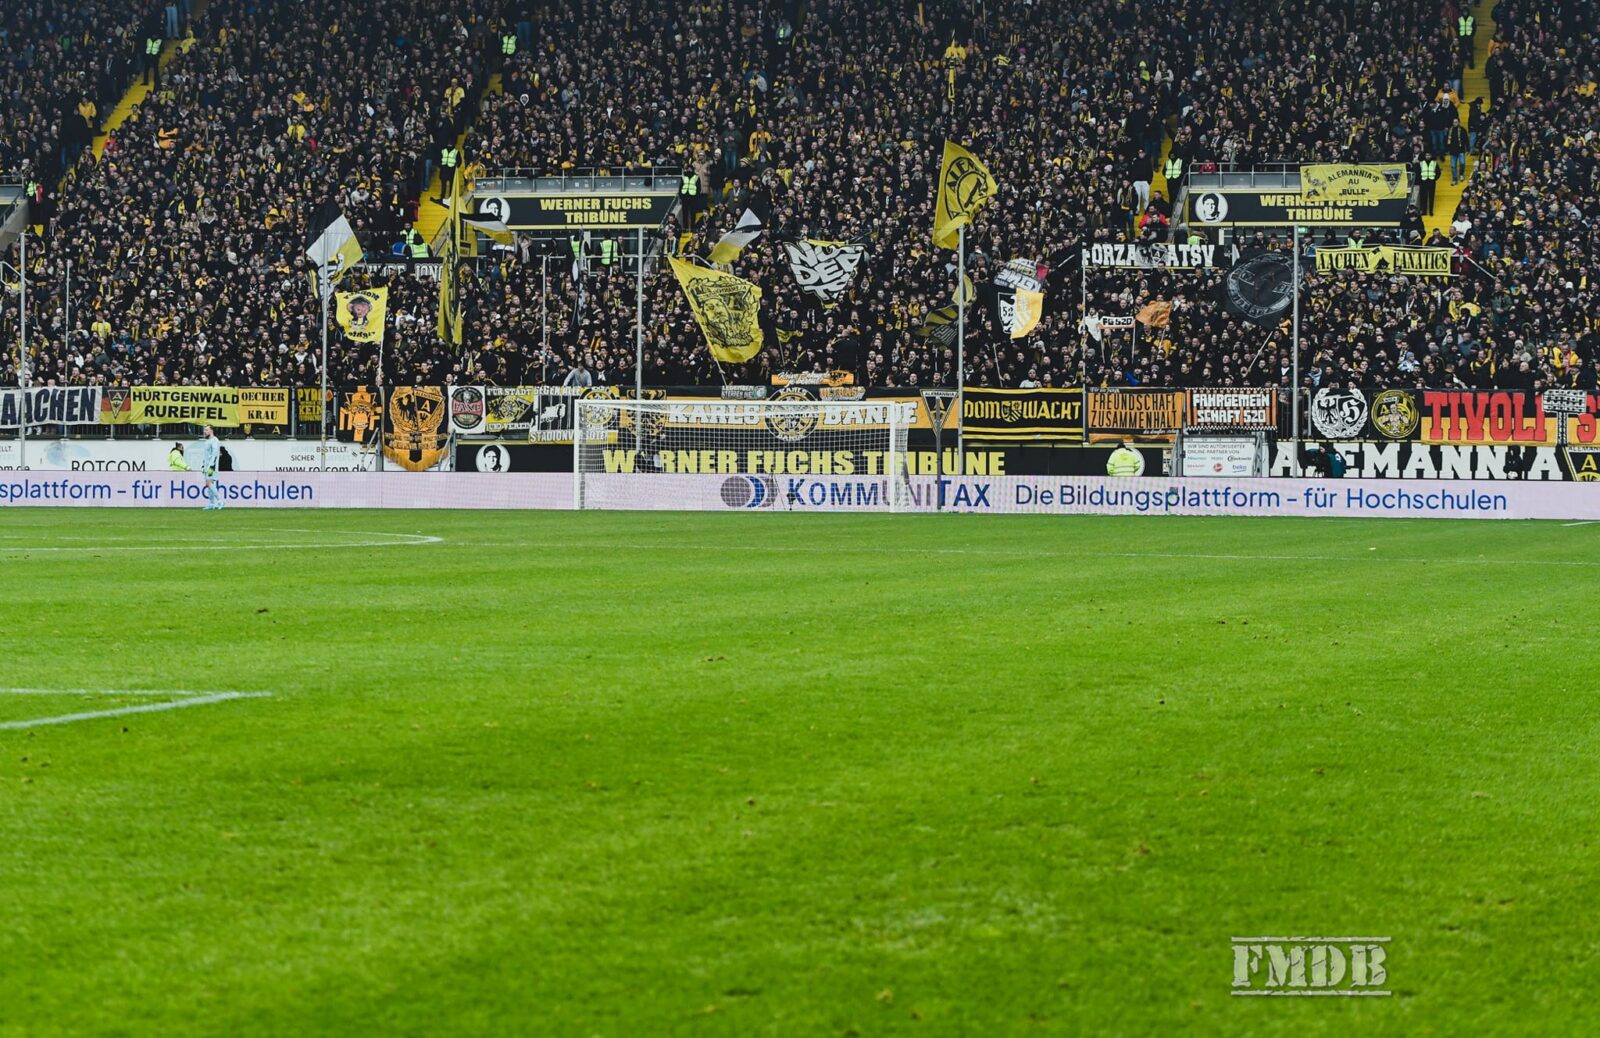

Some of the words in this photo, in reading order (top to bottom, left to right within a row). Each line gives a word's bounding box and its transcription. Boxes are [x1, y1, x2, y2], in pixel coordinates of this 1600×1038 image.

[540, 198, 600, 210] WERNER
[604, 198, 652, 210] FUCHS
[564, 210, 627, 223] TRIBÜNE
[1286, 207, 1353, 220] TRIBÜNE
[1168, 244, 1215, 267] ATSV
[1317, 251, 1370, 270] AACHEN
[1393, 252, 1448, 270] FANATICS
[132, 389, 239, 404] HÜRTGENWALD
[241, 392, 285, 402] OECHER
[487, 388, 502, 396] FÜR
[504, 387, 532, 396] STADT
[1, 388, 96, 425] AACHEN
[1092, 392, 1176, 410] FREUNDSCHAFT
[144, 405, 227, 420] RUREIFEL
[247, 410, 278, 420] KRAU
[963, 400, 1000, 418] DOM
[1022, 400, 1081, 420] WACHT
[1197, 409, 1240, 422] SCHAFT
[1243, 409, 1266, 422] 520
[1424, 391, 1547, 442] TIVOLI
[1091, 410, 1177, 428] ZUSAMMENHALT
[71, 460, 146, 471] ROTCOM
[603, 450, 737, 473] WRNER
[748, 451, 854, 474] FUCHS
[0, 479, 111, 502] splattform
[132, 480, 162, 500] für
[1016, 485, 1053, 505] Die
[1061, 486, 1280, 511] Bildungsplattform
[1304, 488, 1337, 508] für
[1347, 488, 1506, 509] Hochschulen
